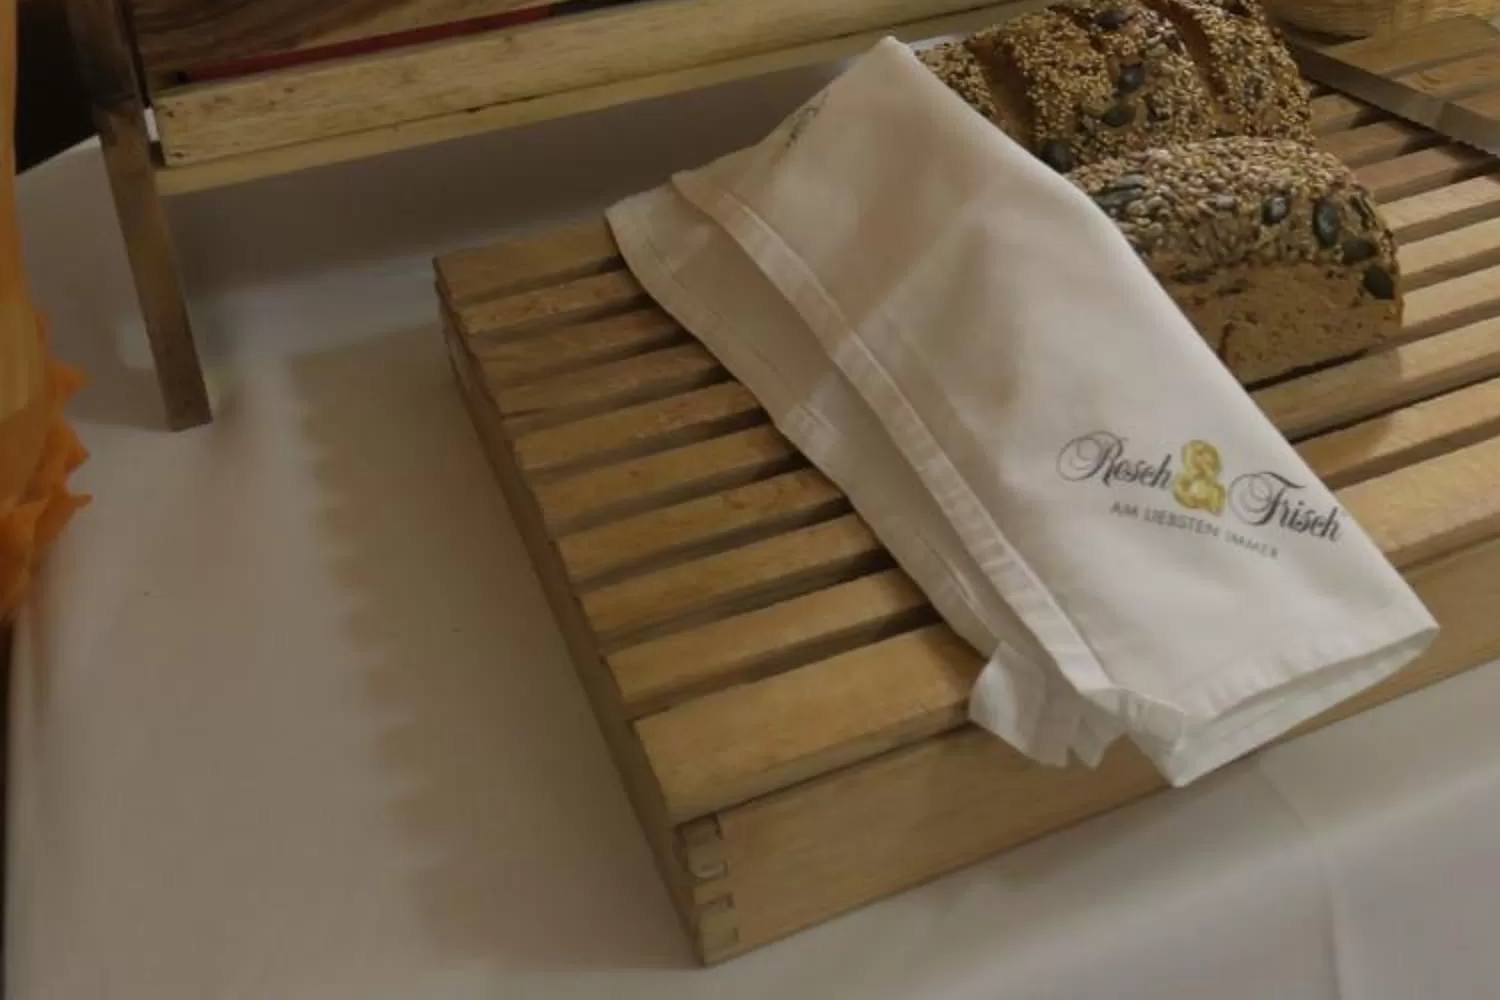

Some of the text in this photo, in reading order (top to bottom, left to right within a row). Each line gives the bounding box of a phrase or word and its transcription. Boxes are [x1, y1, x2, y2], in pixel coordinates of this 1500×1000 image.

[1109, 501, 1138, 518] AM
[1172, 439, 1227, 516] &
[1228, 471, 1342, 542] Frisch
